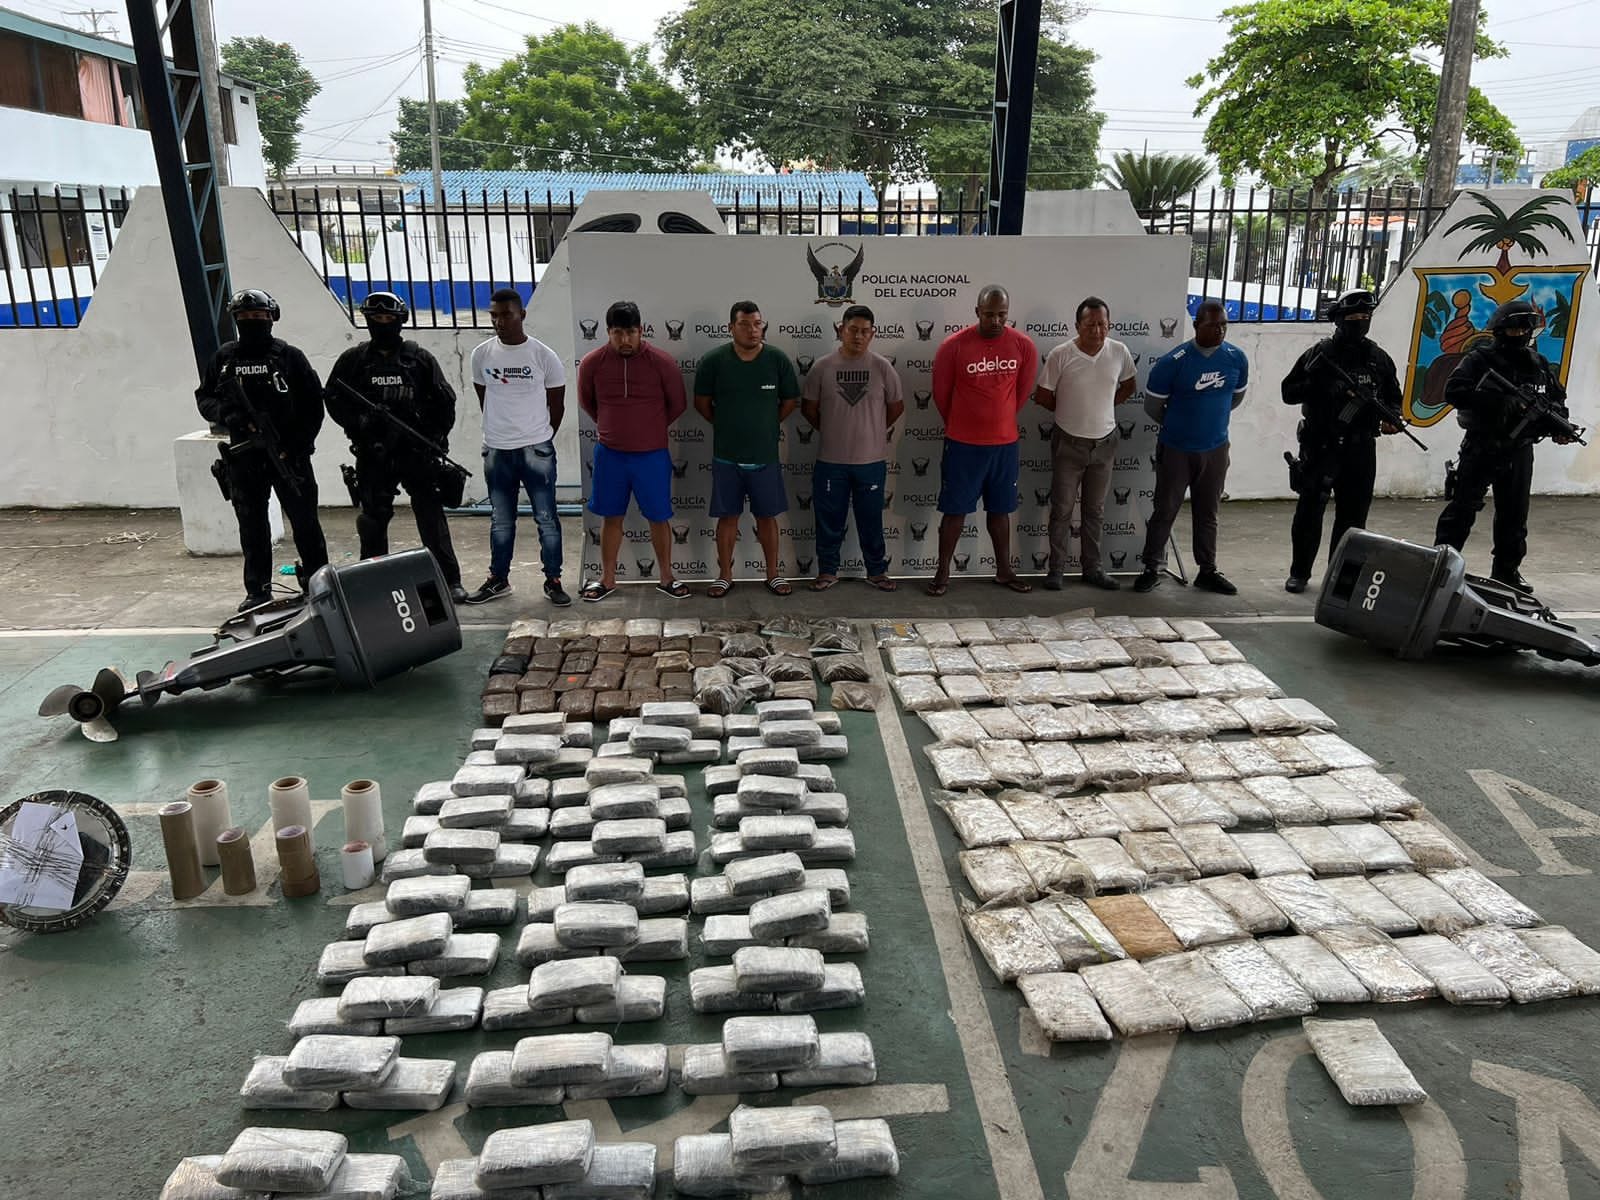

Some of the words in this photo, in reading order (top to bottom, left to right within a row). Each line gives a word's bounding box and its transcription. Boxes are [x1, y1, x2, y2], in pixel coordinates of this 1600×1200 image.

[862, 275, 908, 284] POLICIA
[910, 274, 970, 284] NACIONAL
[874, 288, 897, 298] DEL
[900, 288, 957, 297] ECUADOR
[695, 325, 728, 333] POLIC
[779, 323, 822, 334] POLICÍA
[872, 323, 904, 333] OLICÍA
[1026, 322, 1069, 332] POLICÍA
[1107, 320, 1150, 331] POLICÍA
[235, 365, 269, 375] POLICIA
[966, 356, 1018, 374] adelca
[371, 375, 403, 385] POLICIA
[836, 370, 870, 382] PUMA
[668, 427, 704, 437] OLICÍA
[1113, 456, 1140, 465] LICÍA
[671, 495, 706, 504] OLICÍA
[1102, 521, 1136, 531] OLICÍA
[672, 560, 707, 570] OLICÍA
[1362, 570, 1386, 611] 200
[391, 589, 416, 633] 200
